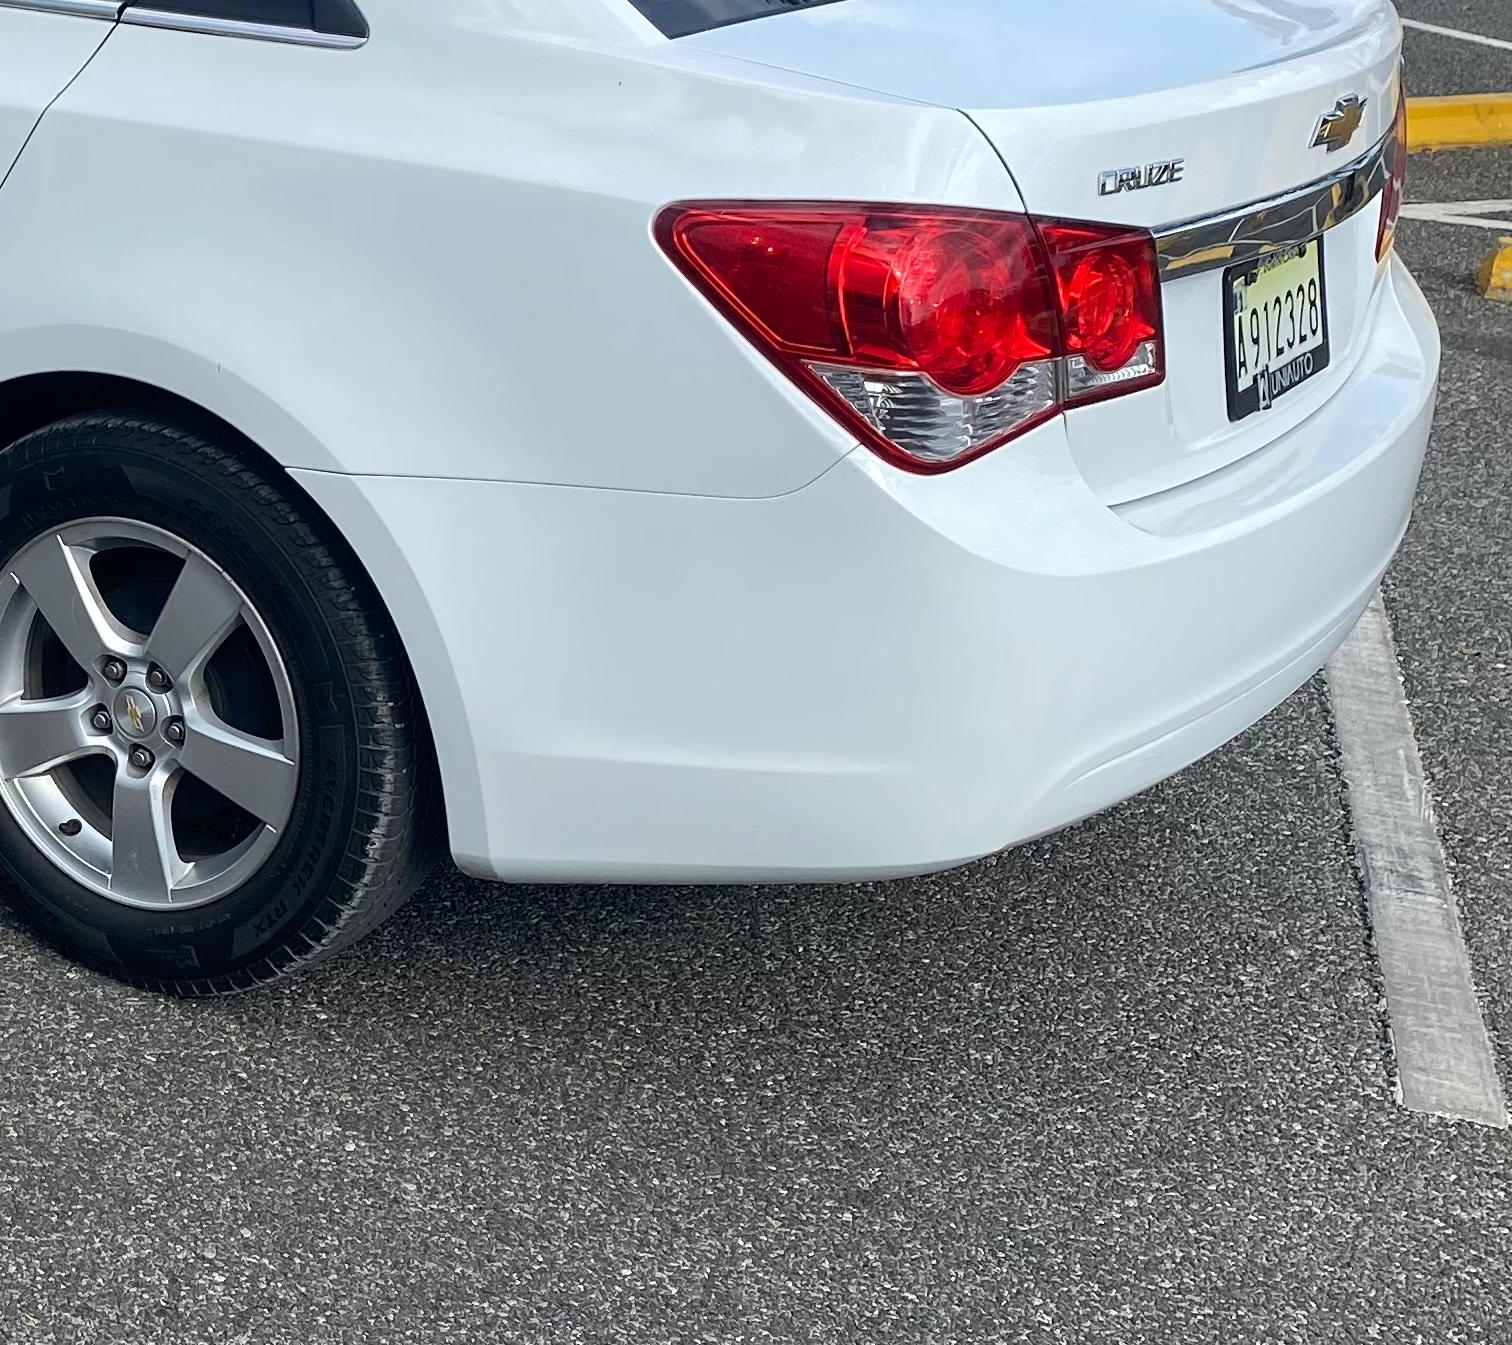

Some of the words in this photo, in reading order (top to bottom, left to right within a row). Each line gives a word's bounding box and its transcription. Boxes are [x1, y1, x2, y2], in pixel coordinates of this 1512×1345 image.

[1098, 159, 1184, 195] CRUZE
[1238, 278, 1318, 378] A912328
[1271, 352, 1314, 395] UNIAUTO
